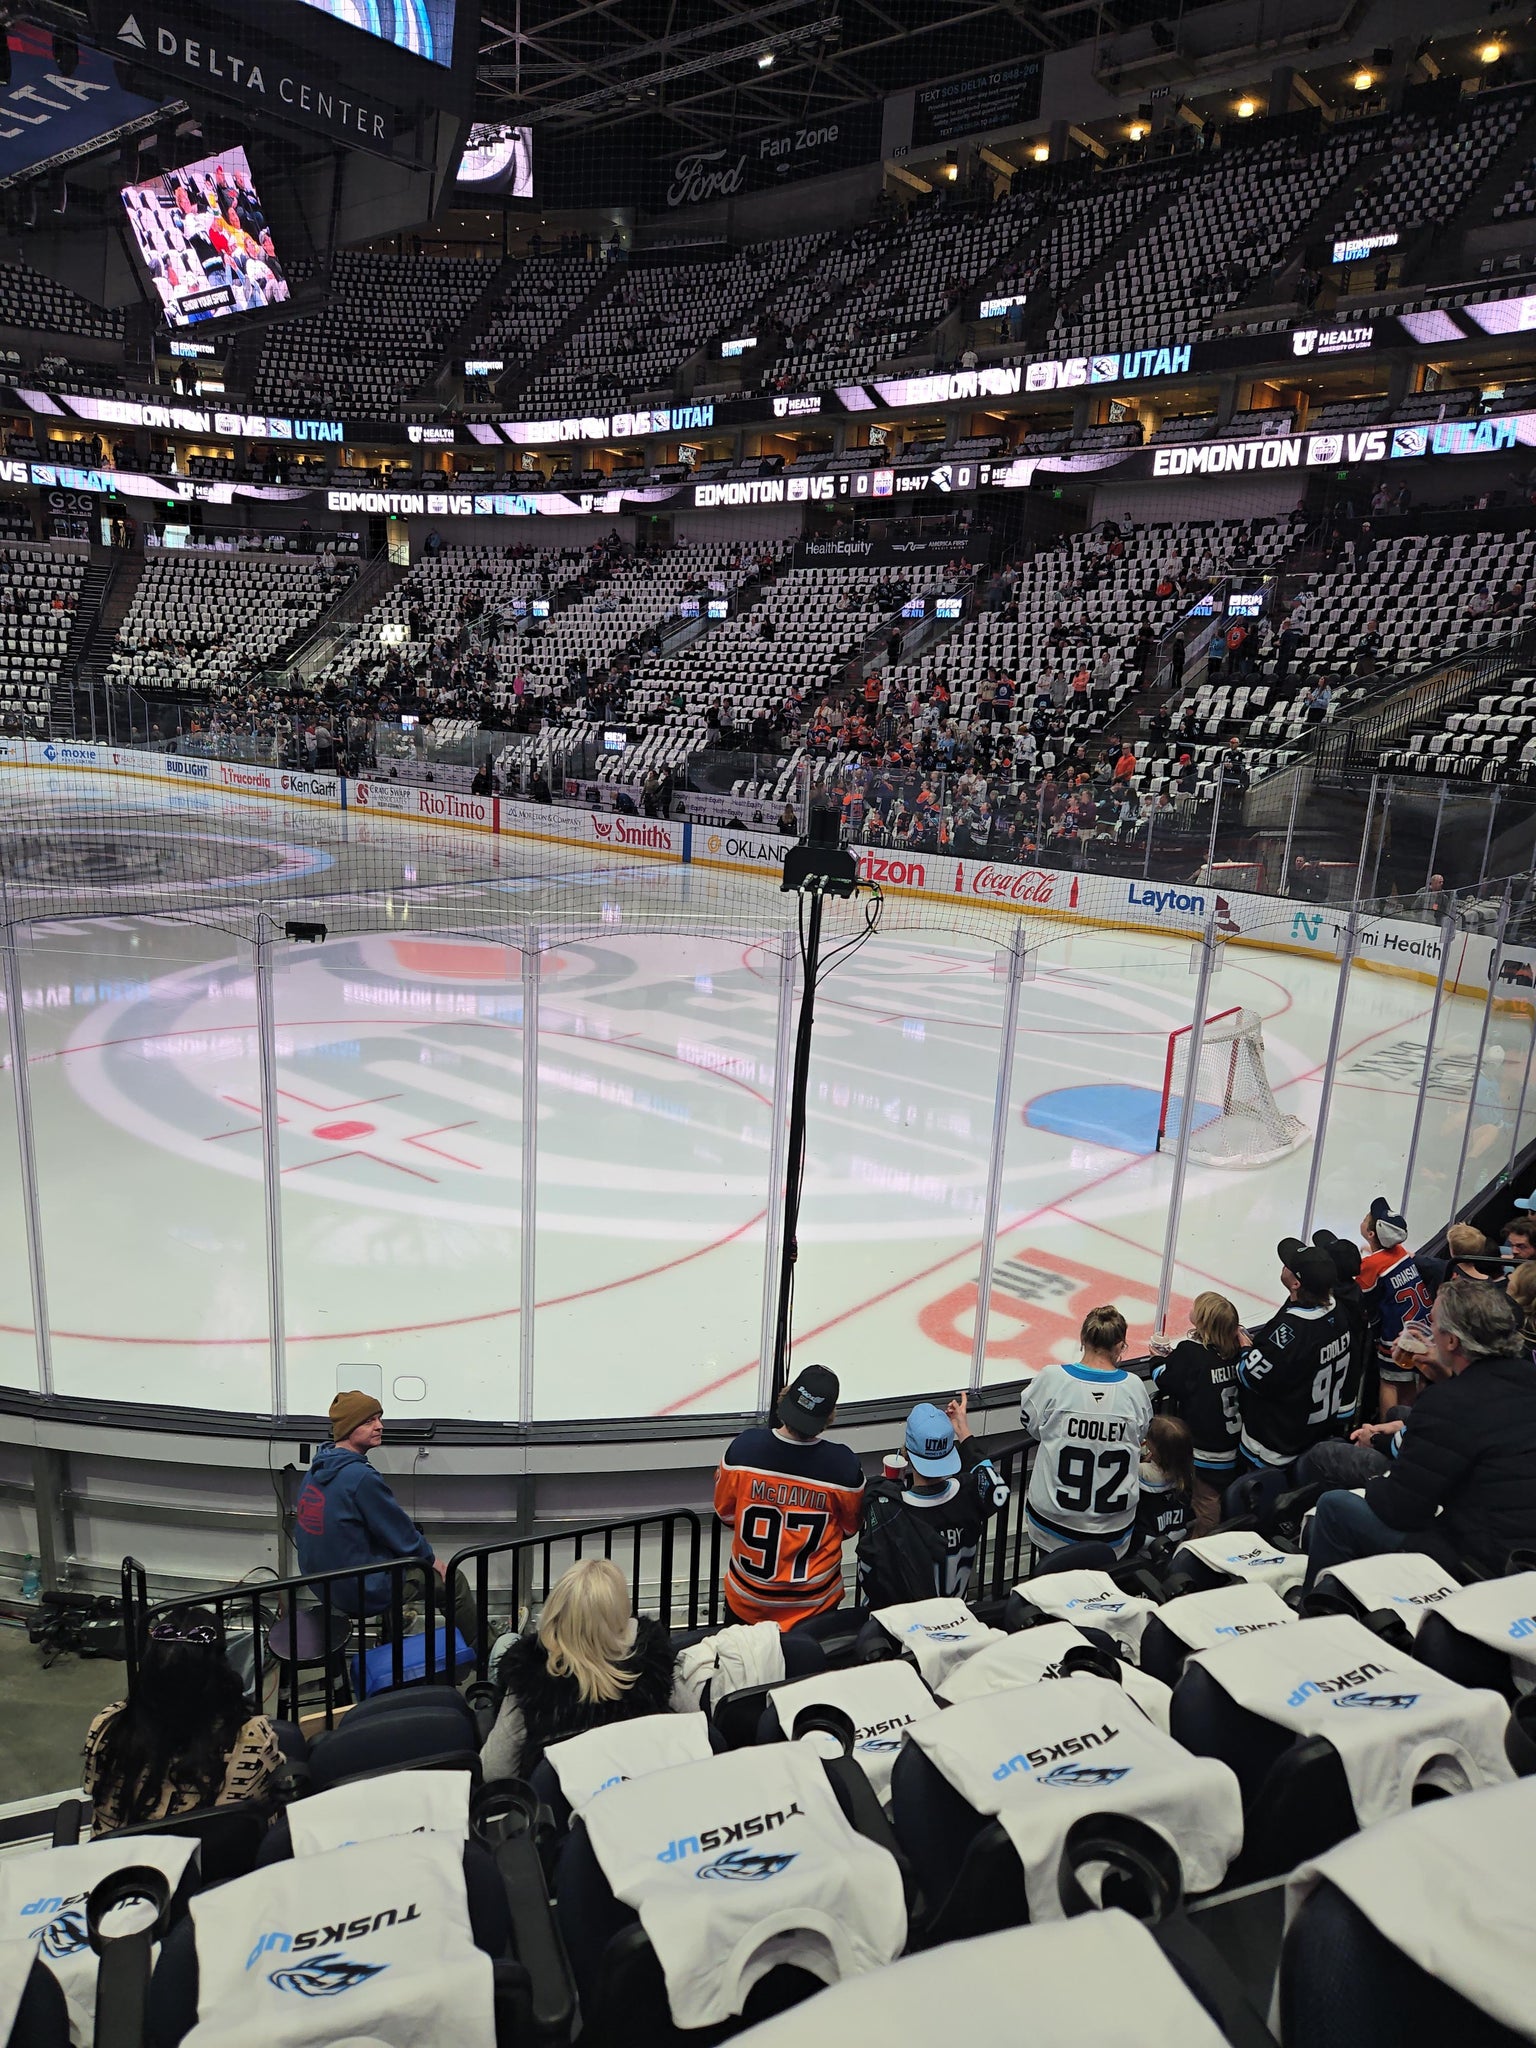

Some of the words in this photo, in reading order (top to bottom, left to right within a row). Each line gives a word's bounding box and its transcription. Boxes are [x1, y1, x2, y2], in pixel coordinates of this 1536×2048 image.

[157, 27, 266, 94] DELTA
[279, 77, 387, 139] CENTER
[920, 89, 941, 104] TEXT
[942, 84, 959, 97] SOS
[961, 78, 987, 92] DELTA
[989, 73, 1001, 85] TO
[759, 137, 791, 160] Fan
[794, 124, 839, 151] Zone
[666, 148, 748, 207] Ford
[1345, 248, 1370, 261] UTAH
[1346, 234, 1398, 249] EDMONTON
[1318, 327, 1373, 346] HEALTH
[1056, 358, 1087, 388] VS
[1124, 346, 1191, 379] UTAH
[632, 412, 651, 434] VS
[672, 405, 713, 430] UTAH
[789, 397, 821, 410] HEALTH
[240, 415, 266, 437] VS
[295, 420, 343, 442] UTAH
[423, 428, 454, 438] HEALTH
[1153, 438, 1302, 477] EDMONTON
[1348, 430, 1388, 462] VS
[1432, 418, 1518, 455] UTAH
[0, 461, 28, 483] VS
[58, 468, 116, 493] UTAH
[695, 479, 784, 507] EDMONTON
[810, 476, 835, 500] VS
[857, 475, 868, 494] 0
[895, 475, 929, 492] 19:47
[958, 468, 970, 486] 0
[48, 491, 94, 512] G2G
[328, 491, 424, 514] EDMONTON
[448, 495, 472, 515] VS
[495, 494, 537, 514] UTAH
[805, 541, 872, 557] HealthEquity
[928, 540, 952, 548] AMERICA
[953, 539, 969, 547] FIRST
[61, 748, 96, 759] moxie
[166, 760, 184, 773] BUD
[184, 762, 208, 778] LIGHT
[229, 768, 270, 788] Trucordia
[615, 817, 672, 850] Smith's
[726, 838, 790, 863] OKLAND
[858, 850, 925, 887] rizon
[972, 865, 1059, 903] Coca-Cola
[1128, 883, 1205, 916] Layton
[1333, 924, 1379, 948] Nmi
[1383, 933, 1443, 962] Health
[1320, 1330, 1351, 1365] COOLEY
[1211, 1364, 1235, 1385] KELLE
[1244, 1348, 1274, 1380] 92
[1307, 1351, 1351, 1425] 92
[925, 1437, 948, 1452] UTAH
[1067, 1417, 1126, 1442] COOLEY
[751, 1478, 827, 1510] McDAVID
[1056, 1445, 1131, 1514] 92
[738, 1503, 830, 1584] 97
[854, 1713, 917, 1741] TUSKS
[993, 1724, 1119, 1783] TUSKSUP
[656, 1801, 806, 1864] TUSKSUP
[245, 1902, 422, 1971] TUSKSUP
